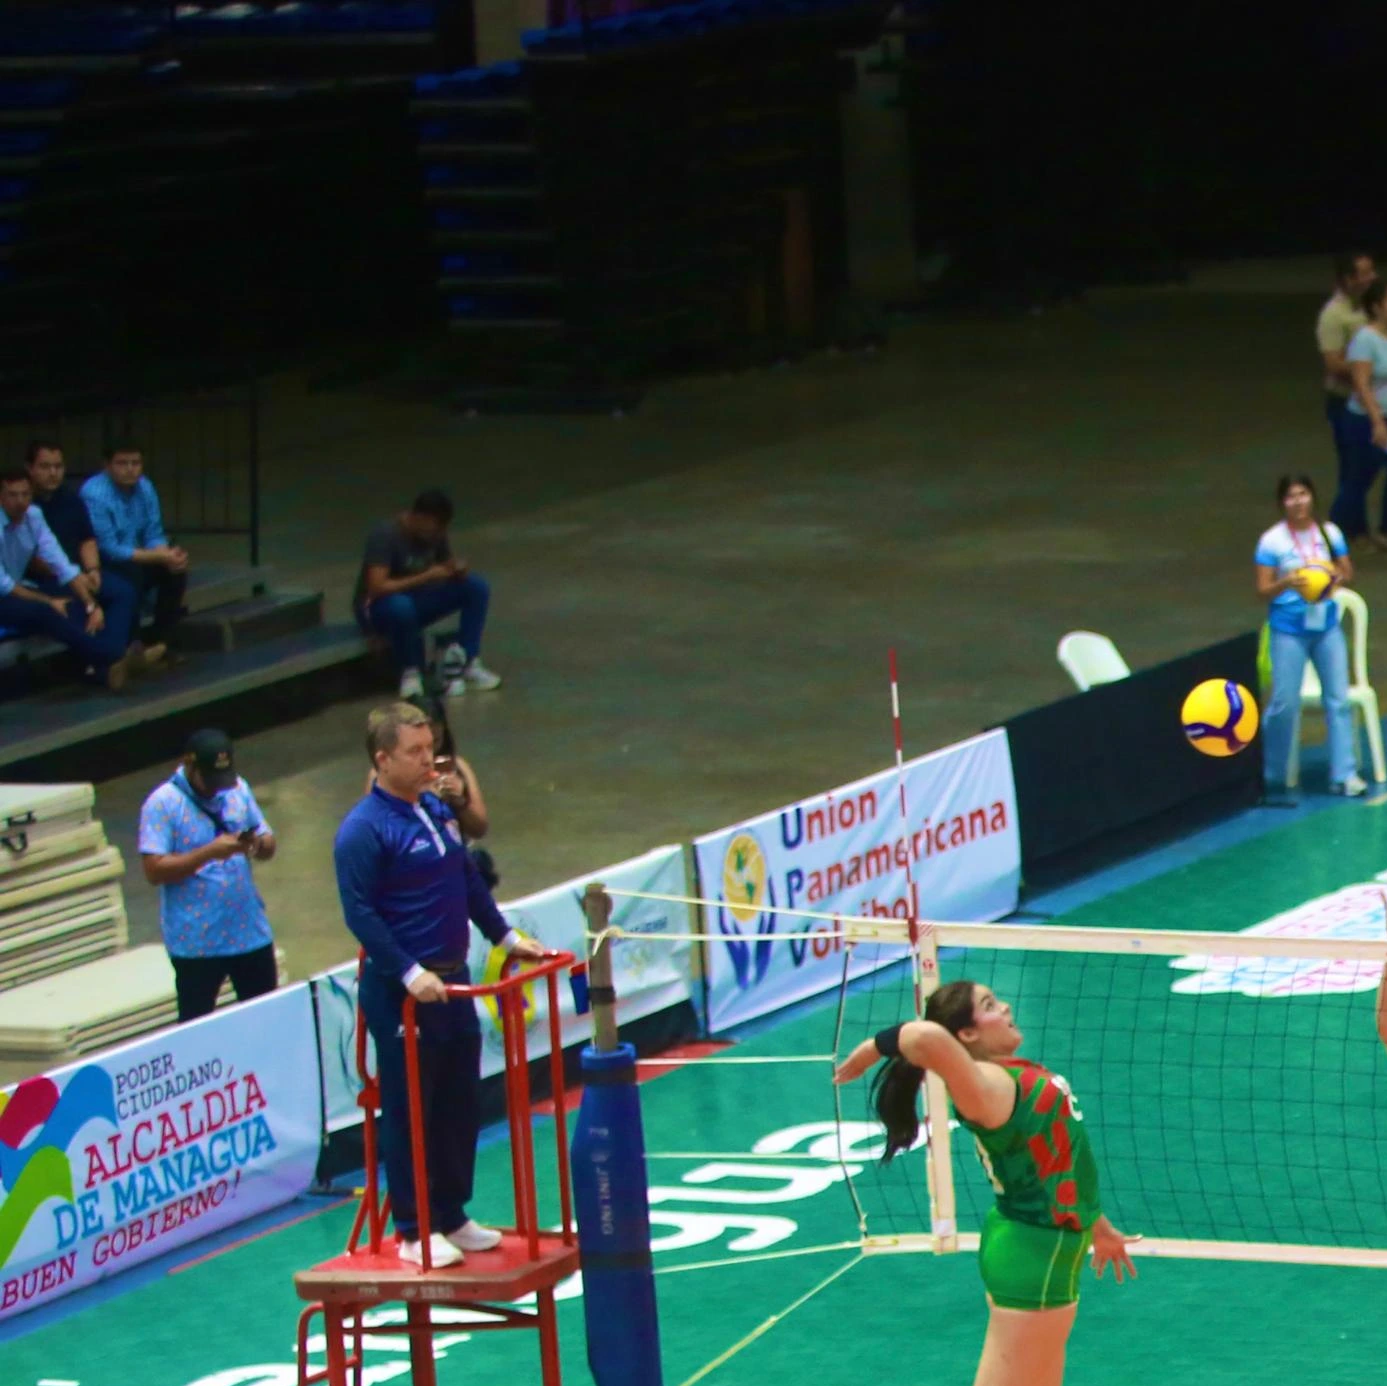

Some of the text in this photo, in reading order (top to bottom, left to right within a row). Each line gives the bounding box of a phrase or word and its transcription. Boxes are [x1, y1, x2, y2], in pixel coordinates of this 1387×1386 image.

[780, 787, 877, 851] Union
[786, 799, 1008, 903] Panamericana
[789, 882, 919, 968] Volibol
[116, 1052, 175, 1095] PODER
[117, 1057, 223, 1121] CIUDADANO
[84, 1065, 267, 1189] ALCALDÍA
[53, 1114, 277, 1250] DE MANAGUA
[0, 1170, 240, 1310] BUEN GOBIERNO!
